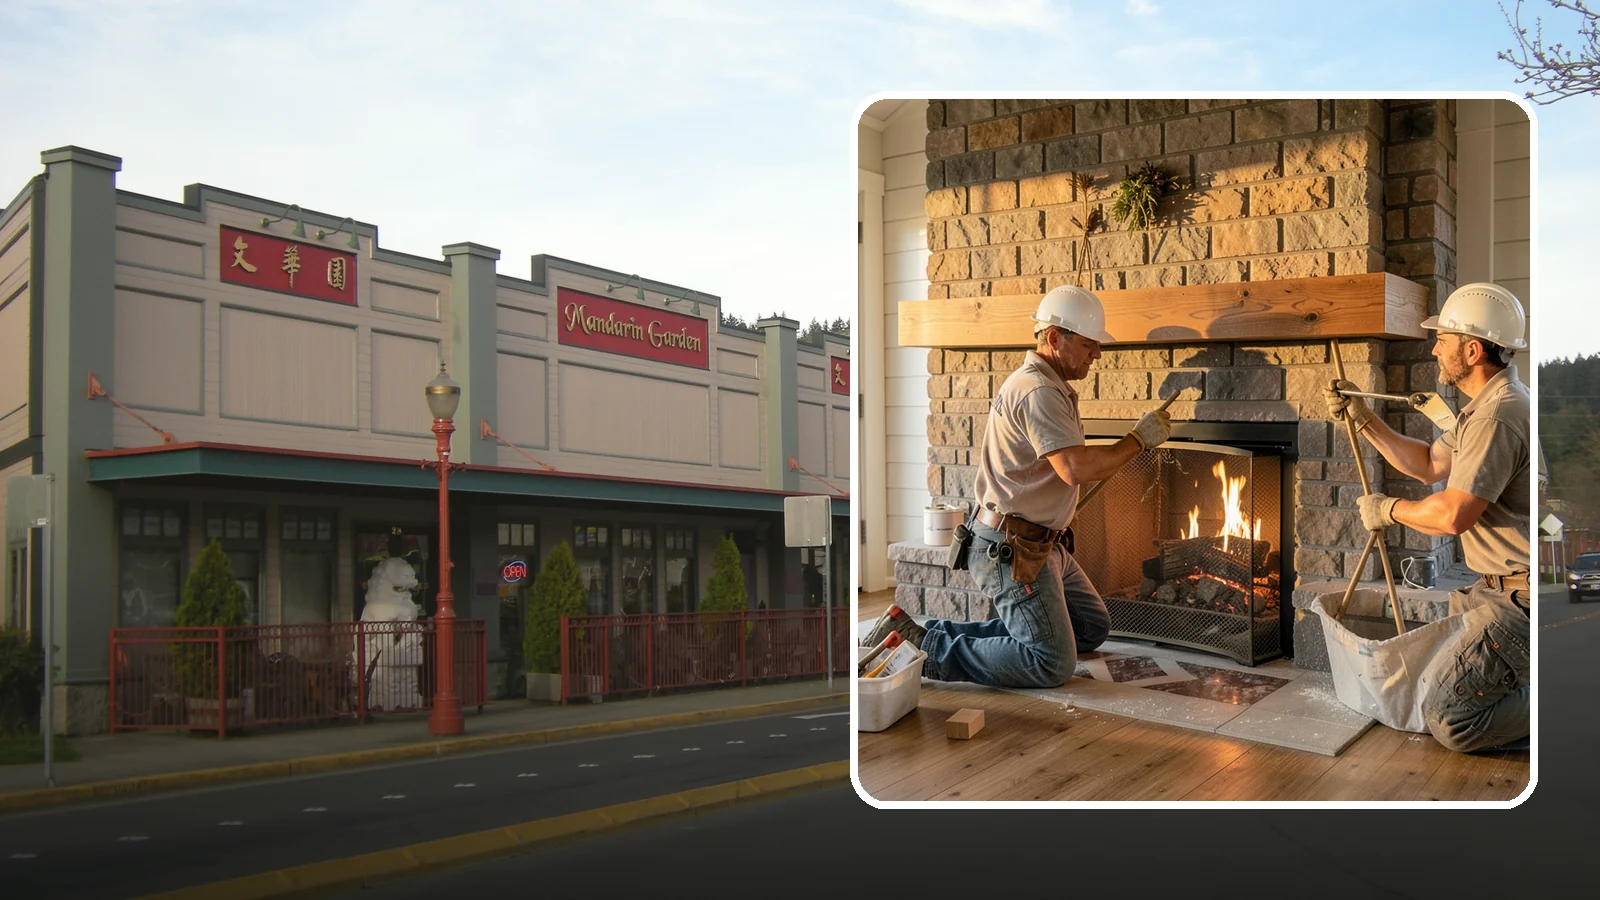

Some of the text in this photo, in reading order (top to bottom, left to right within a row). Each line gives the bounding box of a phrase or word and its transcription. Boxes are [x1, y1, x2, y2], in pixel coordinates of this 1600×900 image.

[230, 235, 346, 291] 文華園
[564, 302, 701, 352] Mandarin Garden
[835, 364, 846, 386] 文
[503, 565, 527, 578] OPEN
